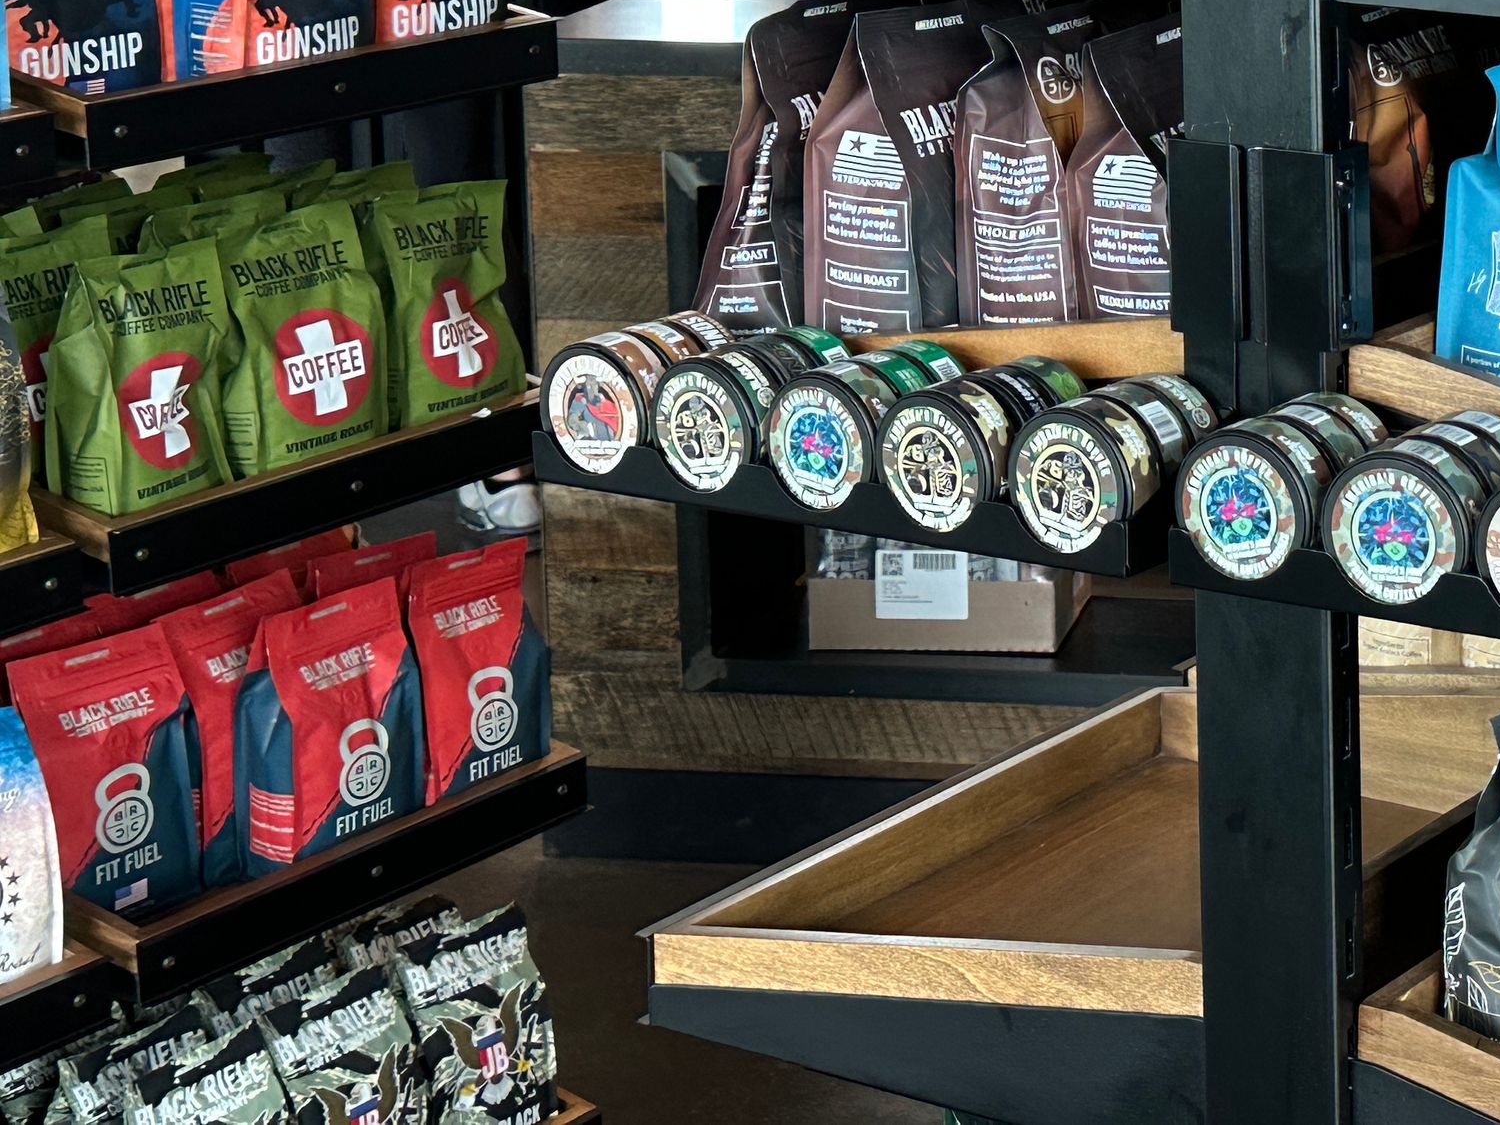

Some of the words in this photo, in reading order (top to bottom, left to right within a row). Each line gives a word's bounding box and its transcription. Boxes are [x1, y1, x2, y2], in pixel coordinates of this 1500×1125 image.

[20, 31, 143, 81] GUNSHIP
[256, 15, 360, 65] GUNSHIP
[828, 198, 858, 214] Serving
[863, 219, 896, 231] people
[393, 220, 452, 251] BLACK
[1091, 224, 1119, 237] Serving
[230, 254, 294, 287] BLACK
[295, 240, 348, 274] RIFLE
[864, 271, 899, 287] ROAST
[98, 292, 163, 324] BLACK
[163, 280, 211, 313] RIFLE
[1016, 291, 1033, 302] the
[1034, 291, 1056, 302] USA
[1136, 298, 1170, 311] ROAST
[288, 344, 364, 385] COFFEE
[286, 431, 338, 454] VINTAGE
[339, 420, 375, 443] ROAST
[433, 604, 469, 631] BLACK
[468, 595, 501, 619] RIFLE
[300, 656, 340, 683] BLACK
[340, 643, 375, 669] RIFLE
[58, 700, 111, 731] BLACK
[111, 687, 155, 715] RIFLE
[469, 760, 491, 782] FIT
[492, 744, 523, 771] FUEL
[336, 811, 360, 838] FIT
[362, 796, 395, 825] FUEL
[95, 861, 122, 885] FIT
[124, 843, 162, 873] FUEL
[405, 951, 468, 995] BLACK
[467, 927, 528, 967] RIFLE
[274, 1022, 336, 1063] BLACK
[336, 988, 398, 1033] RIFLE
[482, 1041, 510, 1080] JB
[134, 1084, 201, 1125] BLACK
[200, 1055, 271, 1101] RIFLE
[498, 1102, 540, 1125] BLACK
